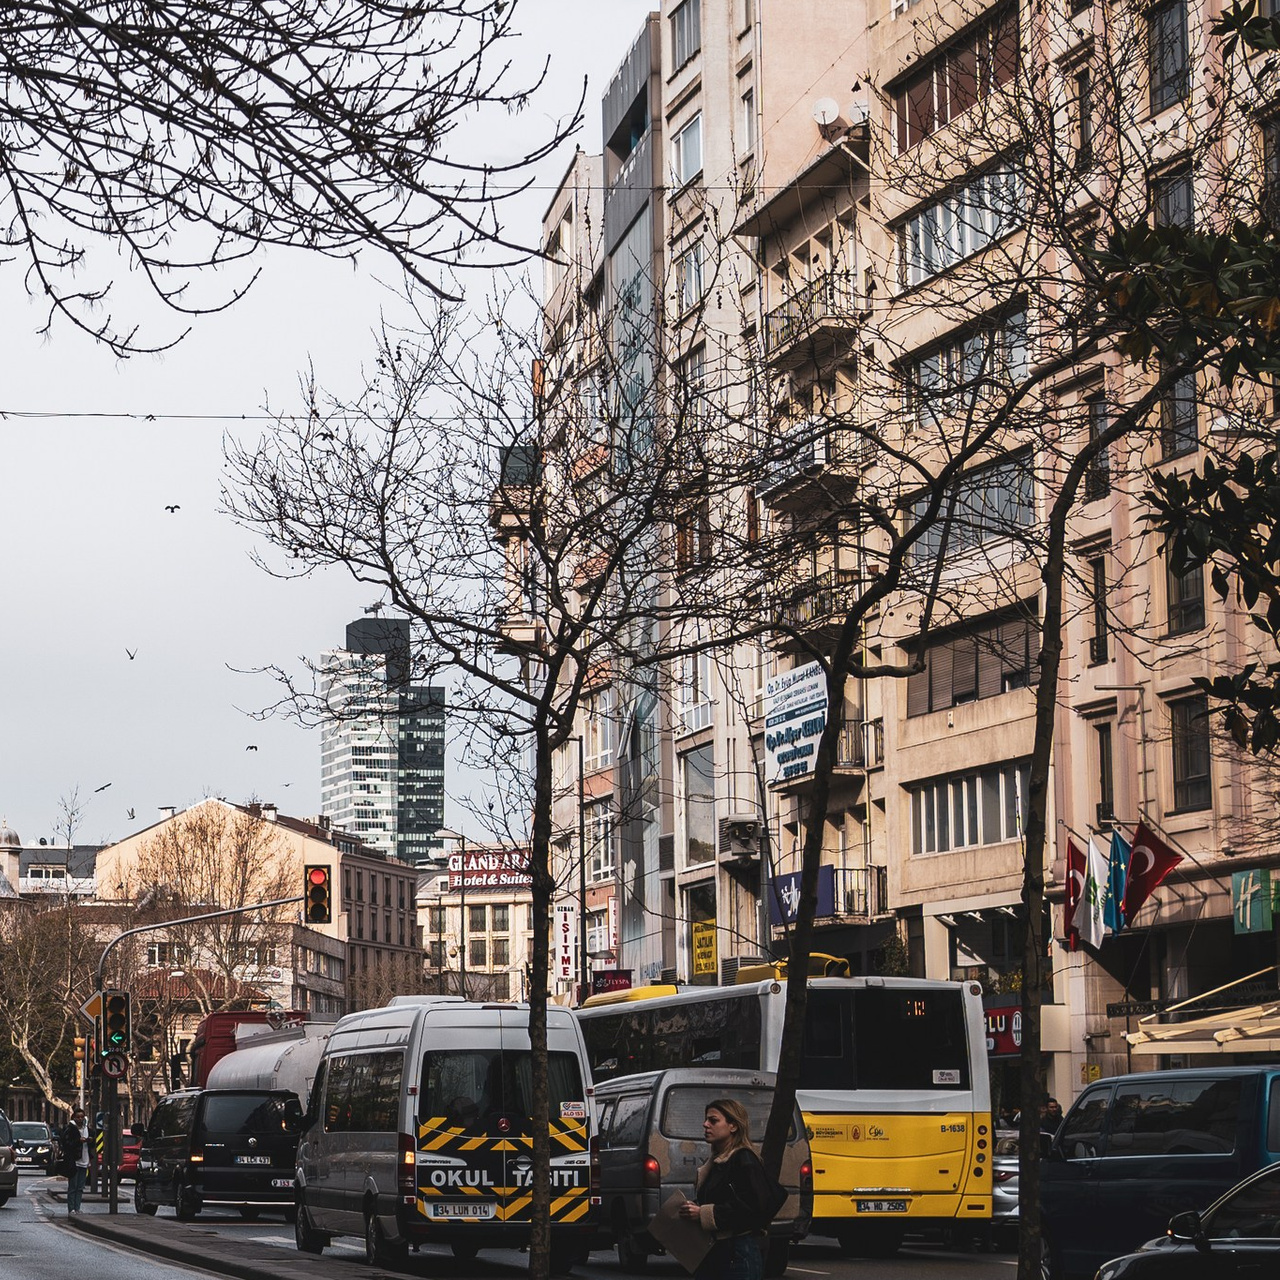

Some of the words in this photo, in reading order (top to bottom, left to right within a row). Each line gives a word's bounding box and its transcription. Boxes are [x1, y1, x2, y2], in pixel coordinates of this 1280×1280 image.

[940, 1125, 965, 1133] B-1638
[430, 1170, 495, 1187] OKUL
[511, 1170, 579, 1187] TAITI
[438, 1205, 449, 1215] 34
[453, 1205, 469, 1215] LUM
[472, 1205, 488, 1215] 014
[861, 1202, 870, 1211] 34
